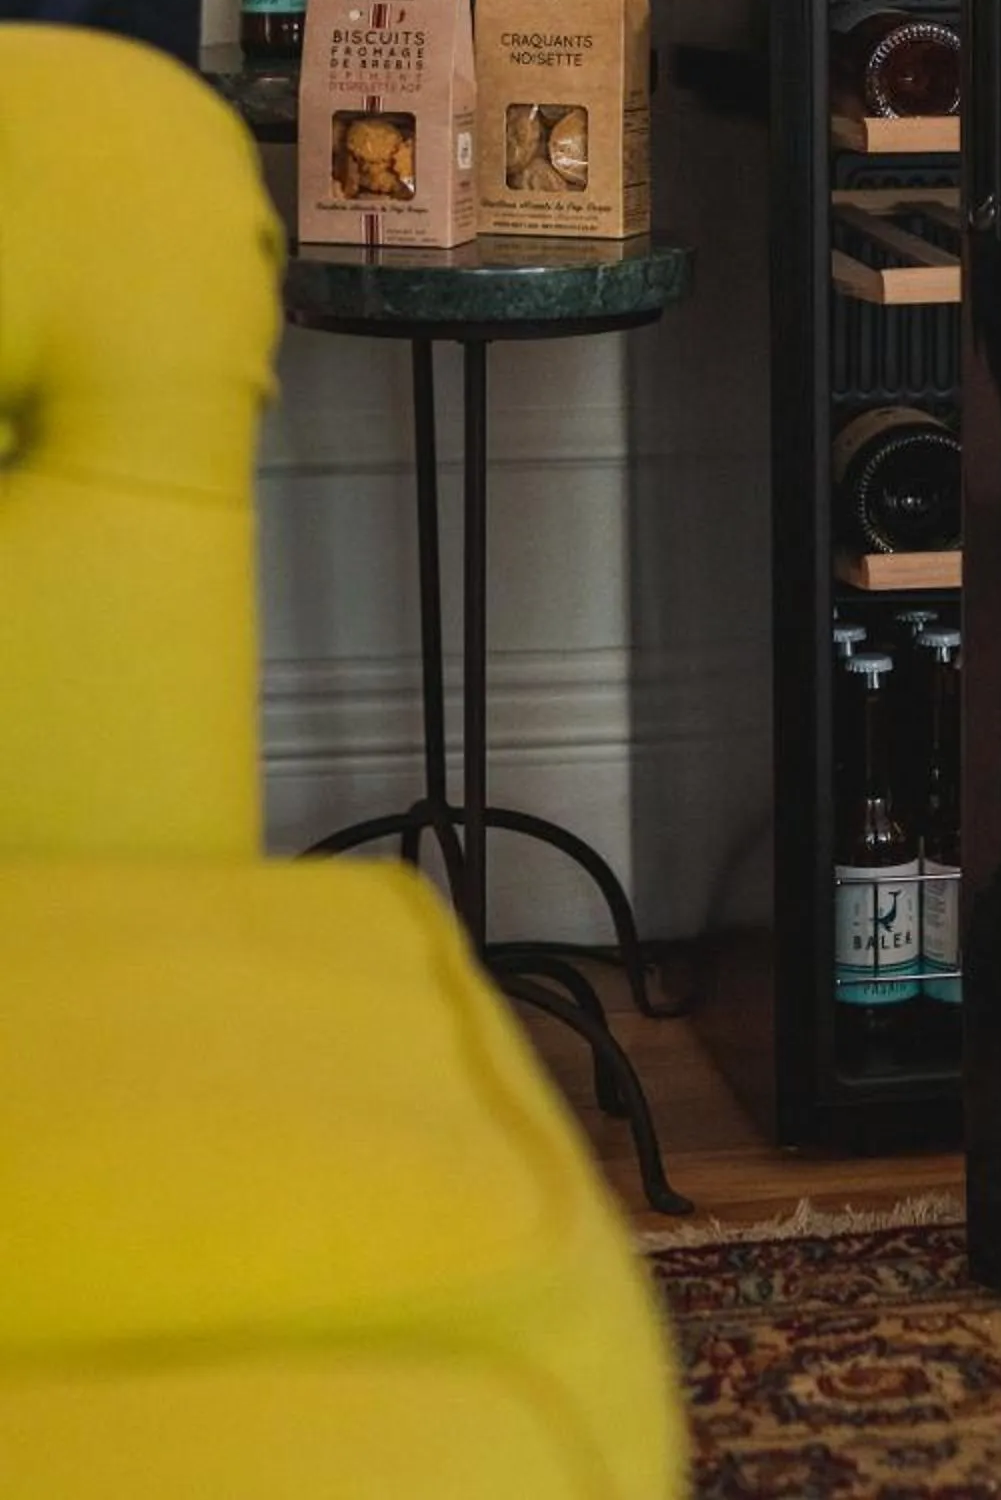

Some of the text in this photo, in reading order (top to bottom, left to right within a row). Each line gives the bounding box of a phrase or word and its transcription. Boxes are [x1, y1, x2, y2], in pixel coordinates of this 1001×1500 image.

[332, 29, 425, 46] BISCUITS
[500, 33, 593, 49] CRAQUANTS
[330, 46, 424, 58] FROMAGE
[510, 52, 583, 66] NOISETTE
